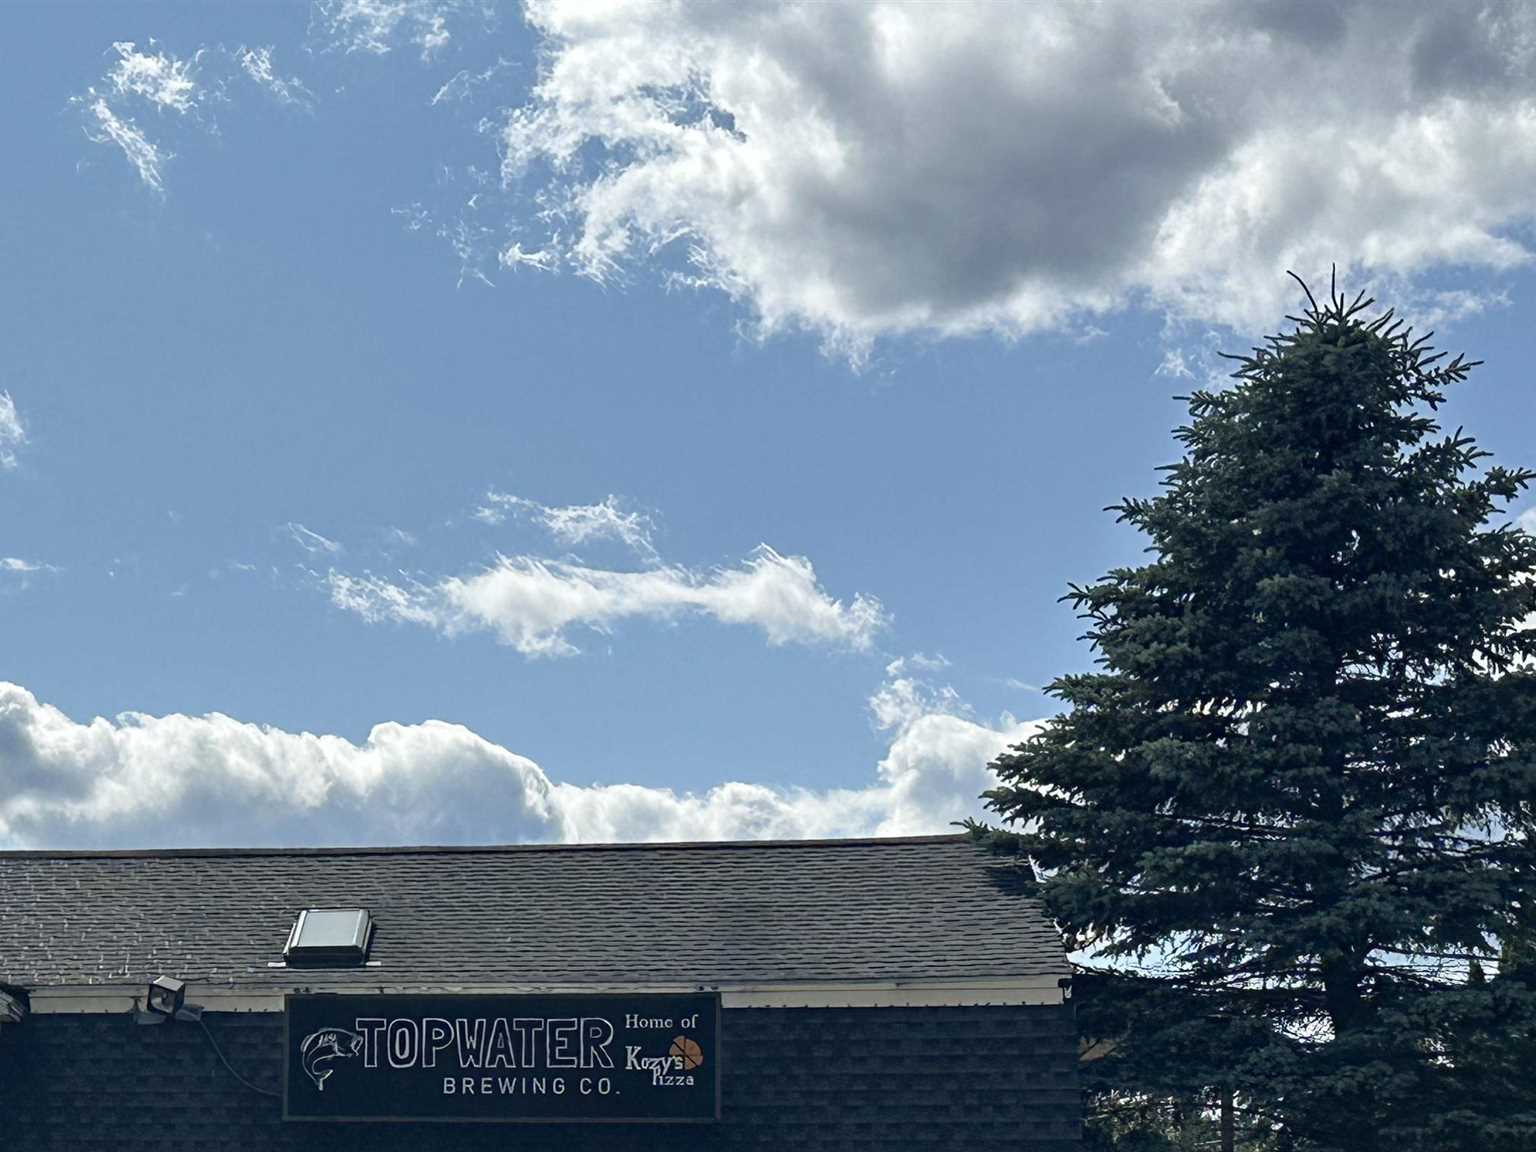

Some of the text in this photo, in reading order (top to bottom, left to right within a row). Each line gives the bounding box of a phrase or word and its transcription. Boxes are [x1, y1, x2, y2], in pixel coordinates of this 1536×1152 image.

[625, 1014, 699, 1029] Home of
[356, 1018, 614, 1068] TOPWATER
[625, 1046, 684, 1076] Kozy's
[443, 1077, 620, 1095] BREWING CO.
[652, 1065, 695, 1086] Pizza
